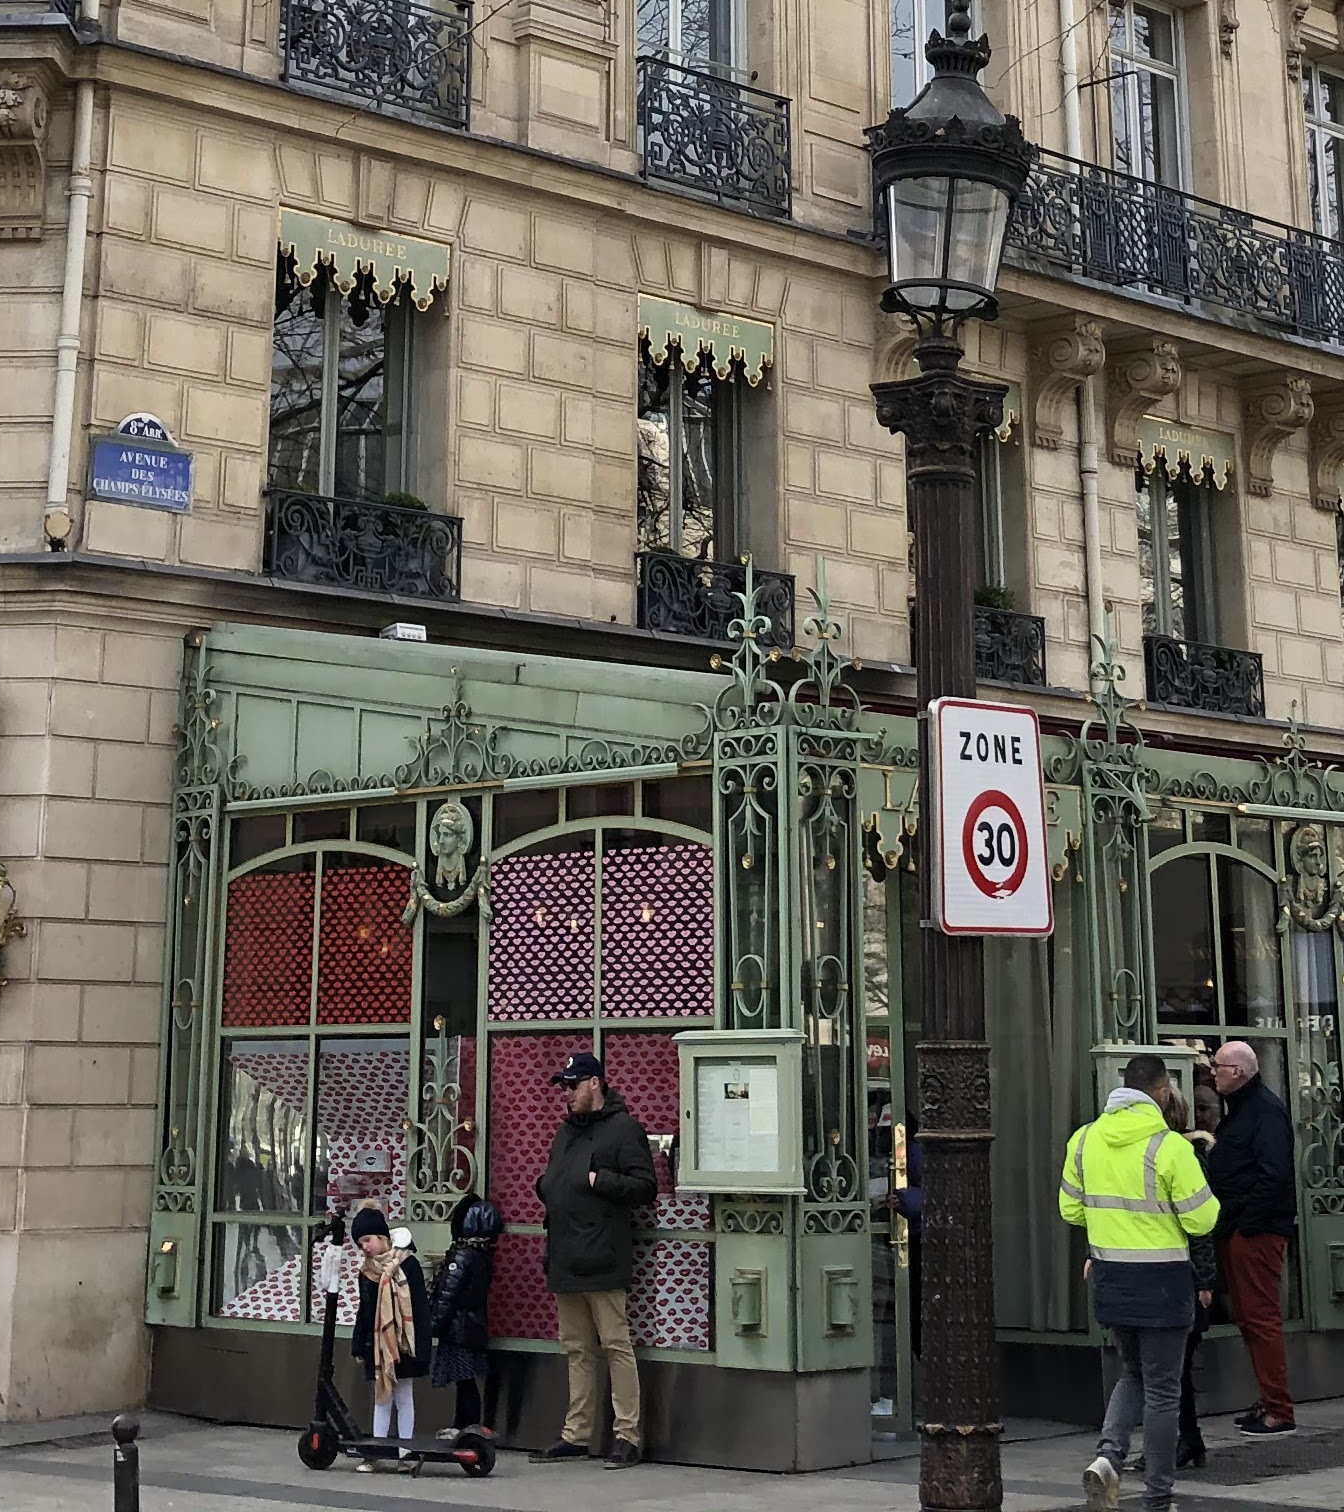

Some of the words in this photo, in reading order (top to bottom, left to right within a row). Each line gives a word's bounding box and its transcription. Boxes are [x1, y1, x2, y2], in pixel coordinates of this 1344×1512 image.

[327, 228, 407, 259] LADUREE
[675, 311, 740, 338] LADUREE
[119, 451, 168, 469] AVENUE
[131, 468, 155, 482] DES
[93, 478, 139, 495] CHAMPS
[141, 482, 189, 502] ÉLYSÉES
[959, 730, 1023, 765] ZONE
[977, 821, 1016, 867] 30
